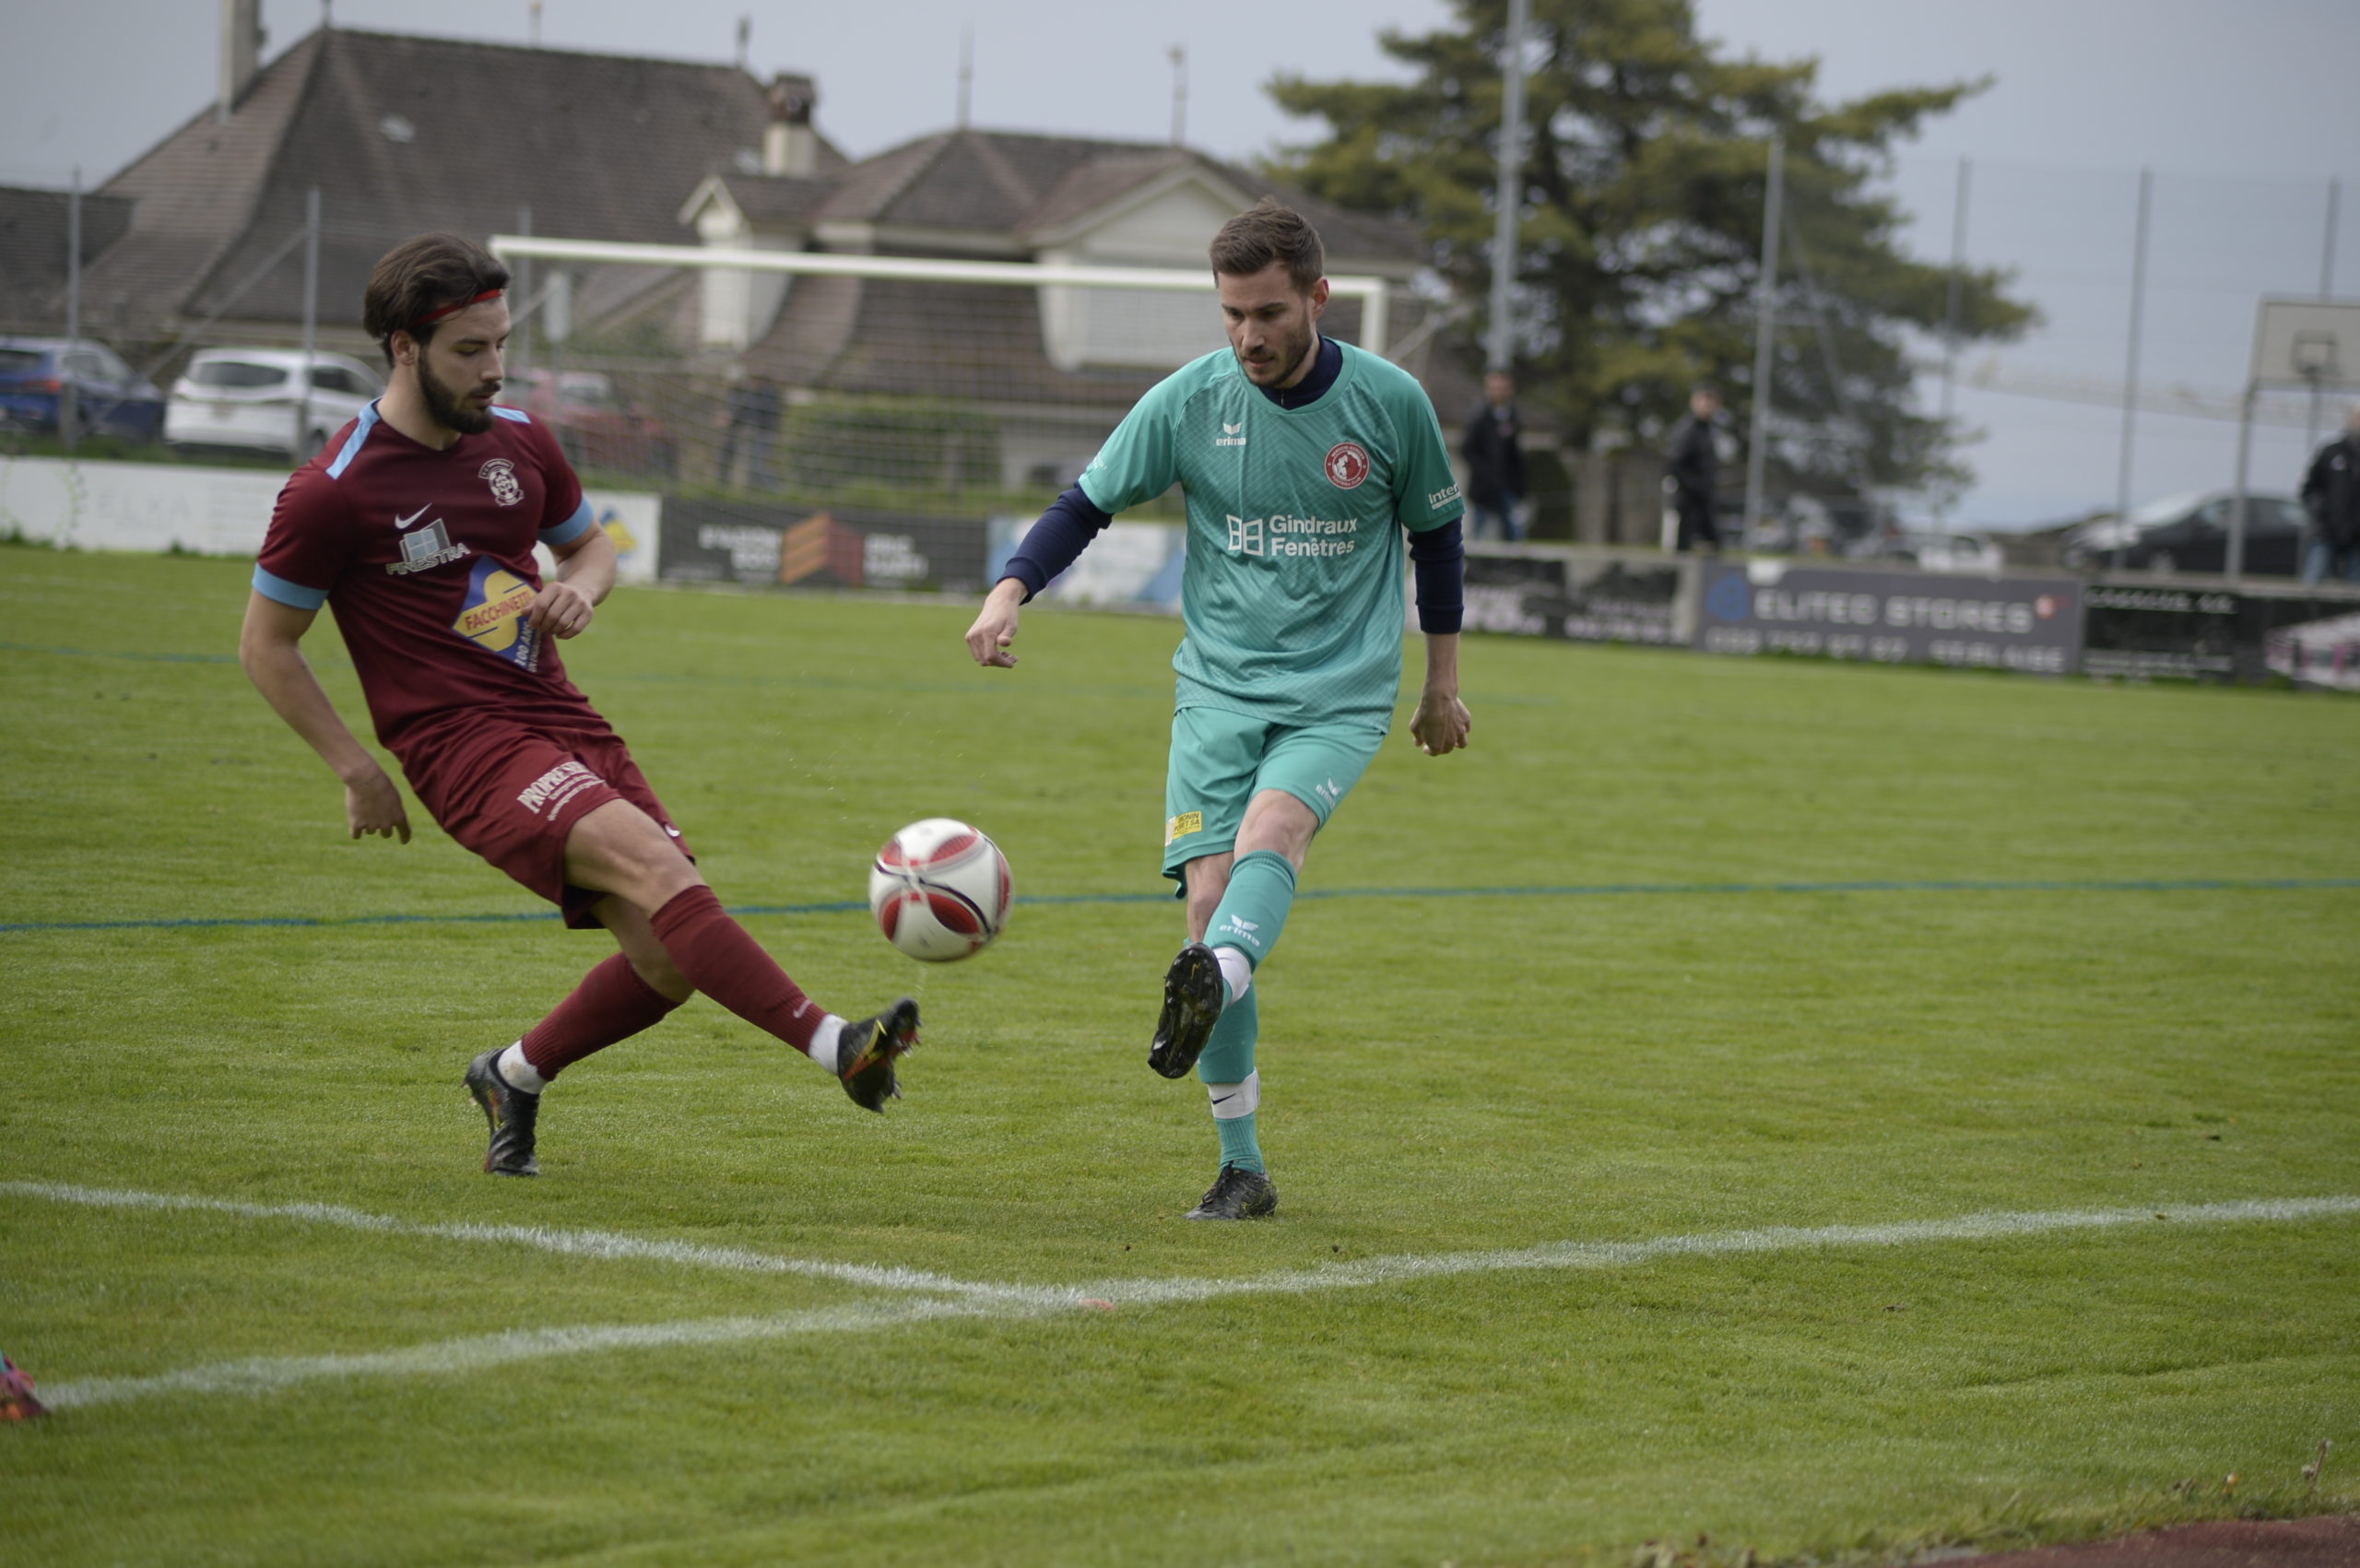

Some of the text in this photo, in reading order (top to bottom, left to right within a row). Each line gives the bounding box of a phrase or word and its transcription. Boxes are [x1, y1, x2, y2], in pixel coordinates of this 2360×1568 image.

[1216, 436, 1246, 446] erima
[1268, 514, 1357, 534] Gindraux
[1270, 537, 1355, 557] Fenêtres
[384, 542, 471, 575] FINESTRA
[1884, 594, 2034, 634] STORES
[1219, 925, 1260, 947] erima
